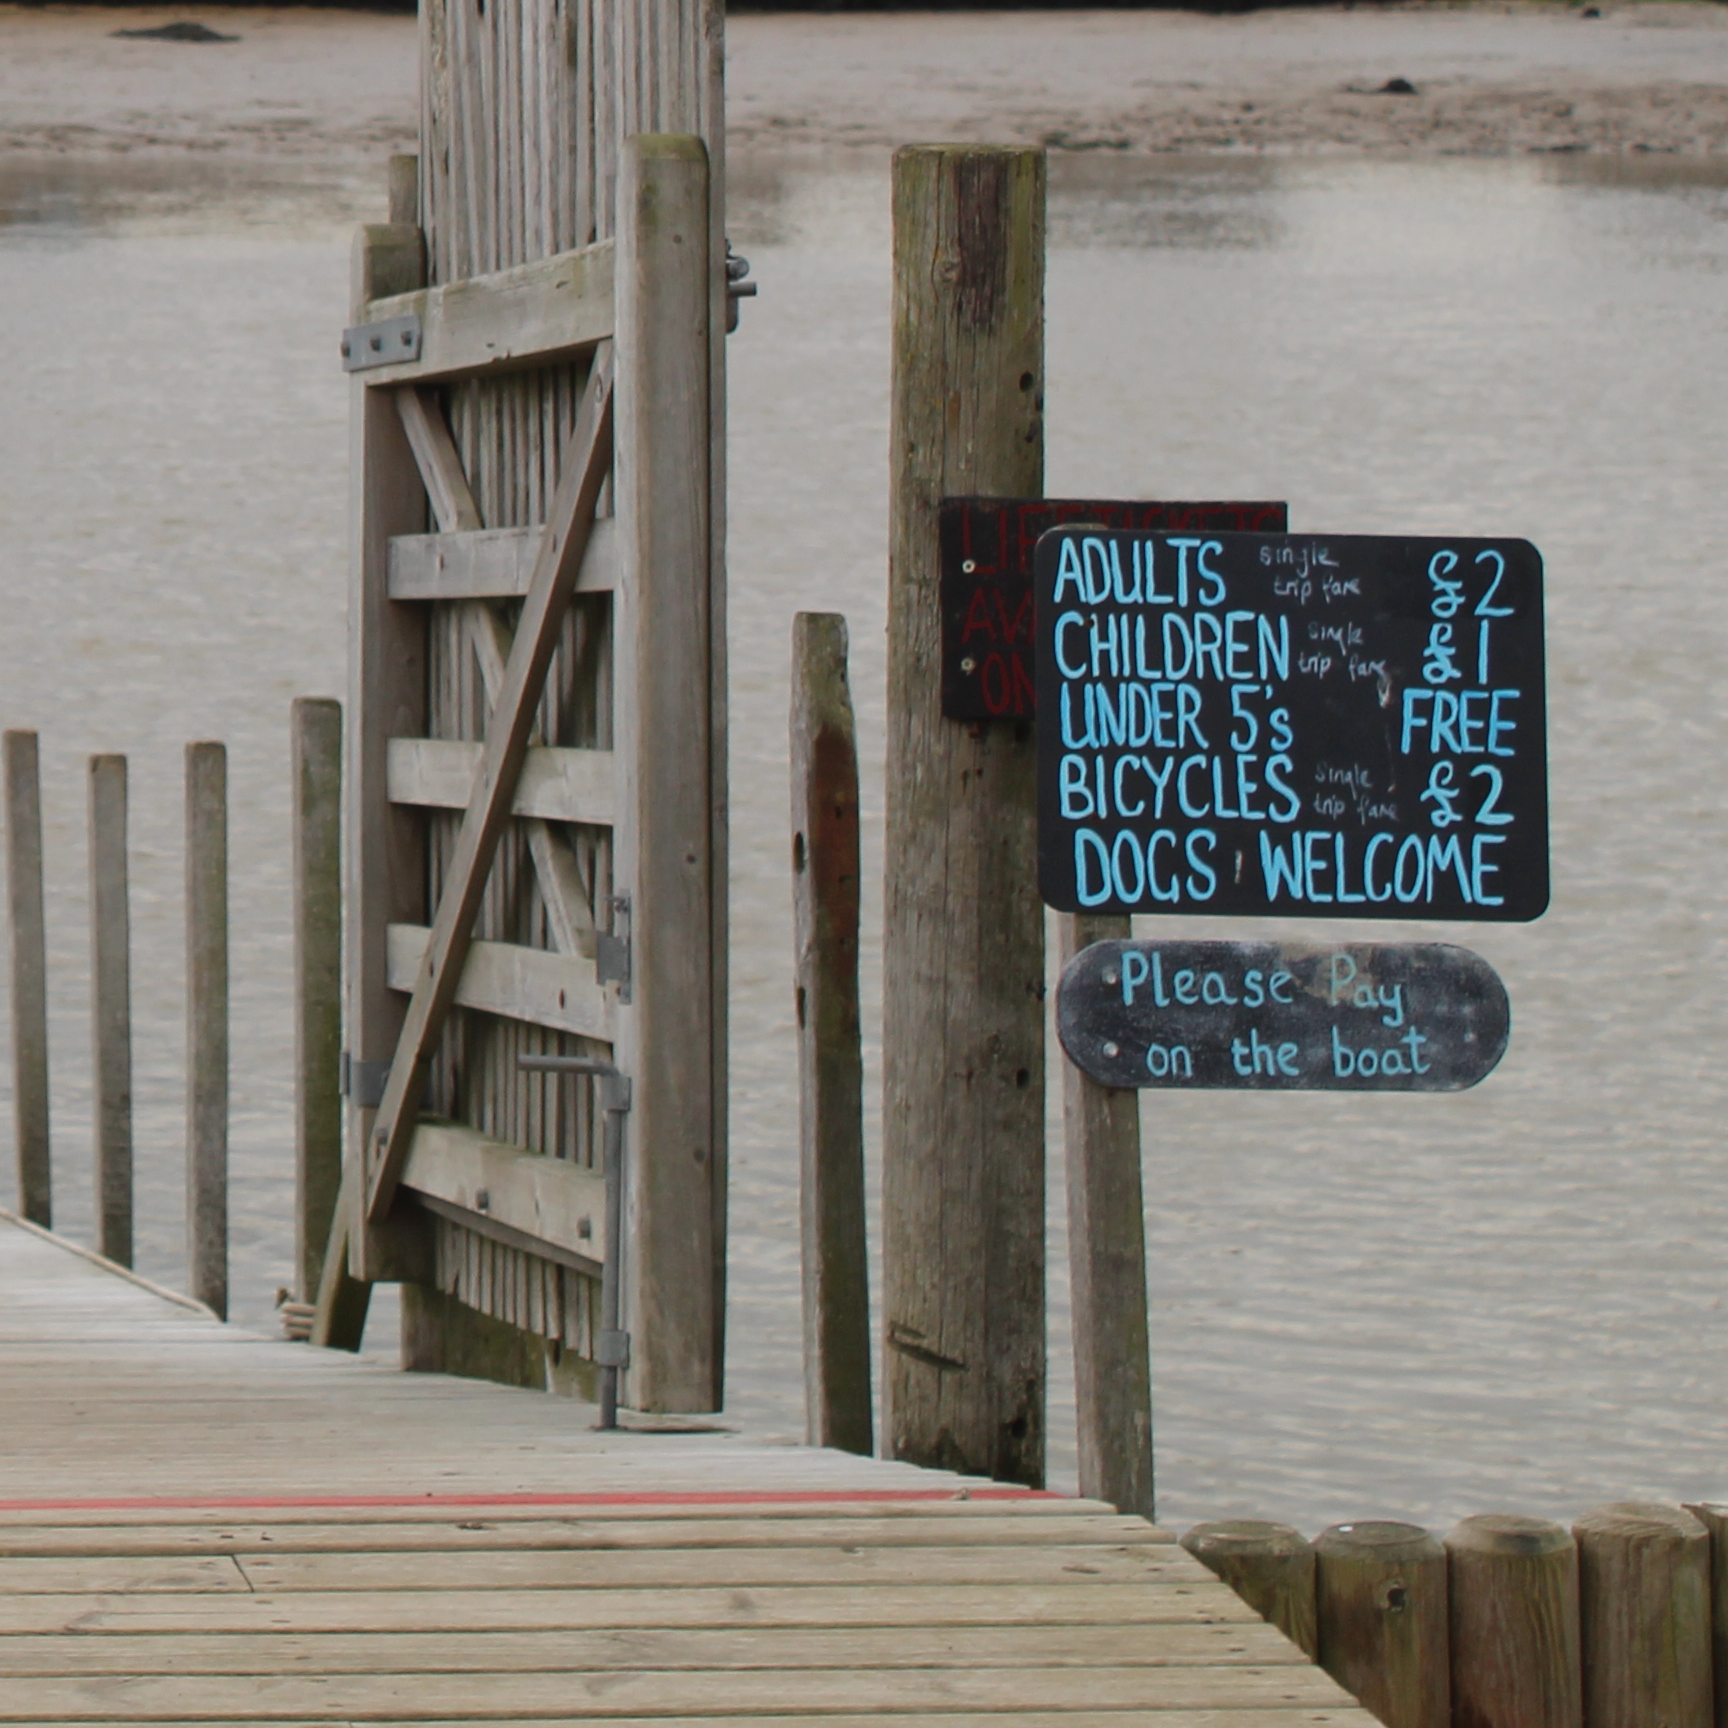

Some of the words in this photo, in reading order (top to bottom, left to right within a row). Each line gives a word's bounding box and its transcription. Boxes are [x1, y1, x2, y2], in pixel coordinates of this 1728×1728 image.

[1053, 537, 1226, 607] ADULTS
[1427, 549, 1515, 618] £2
[1274, 576, 1312, 605] trip
[1322, 574, 1361, 604] fare
[1054, 610, 1290, 681] CHILDREN
[1298, 652, 1332, 679] trip
[1059, 682, 1209, 750] UNDER
[1230, 683, 1294, 753] 5's
[1401, 689, 1521, 756] FREE
[1059, 753, 1301, 823] BICYCLES
[1313, 793, 1346, 820] trip
[1073, 829, 1217, 907] DOGS
[1259, 831, 1508, 905] WELCOME
[1121, 950, 1294, 1008] Please
[1330, 953, 1403, 1027] Pay
[1145, 1043, 1193, 1079] on
[1231, 1028, 1301, 1077] the
[1331, 1025, 1432, 1078] boat
